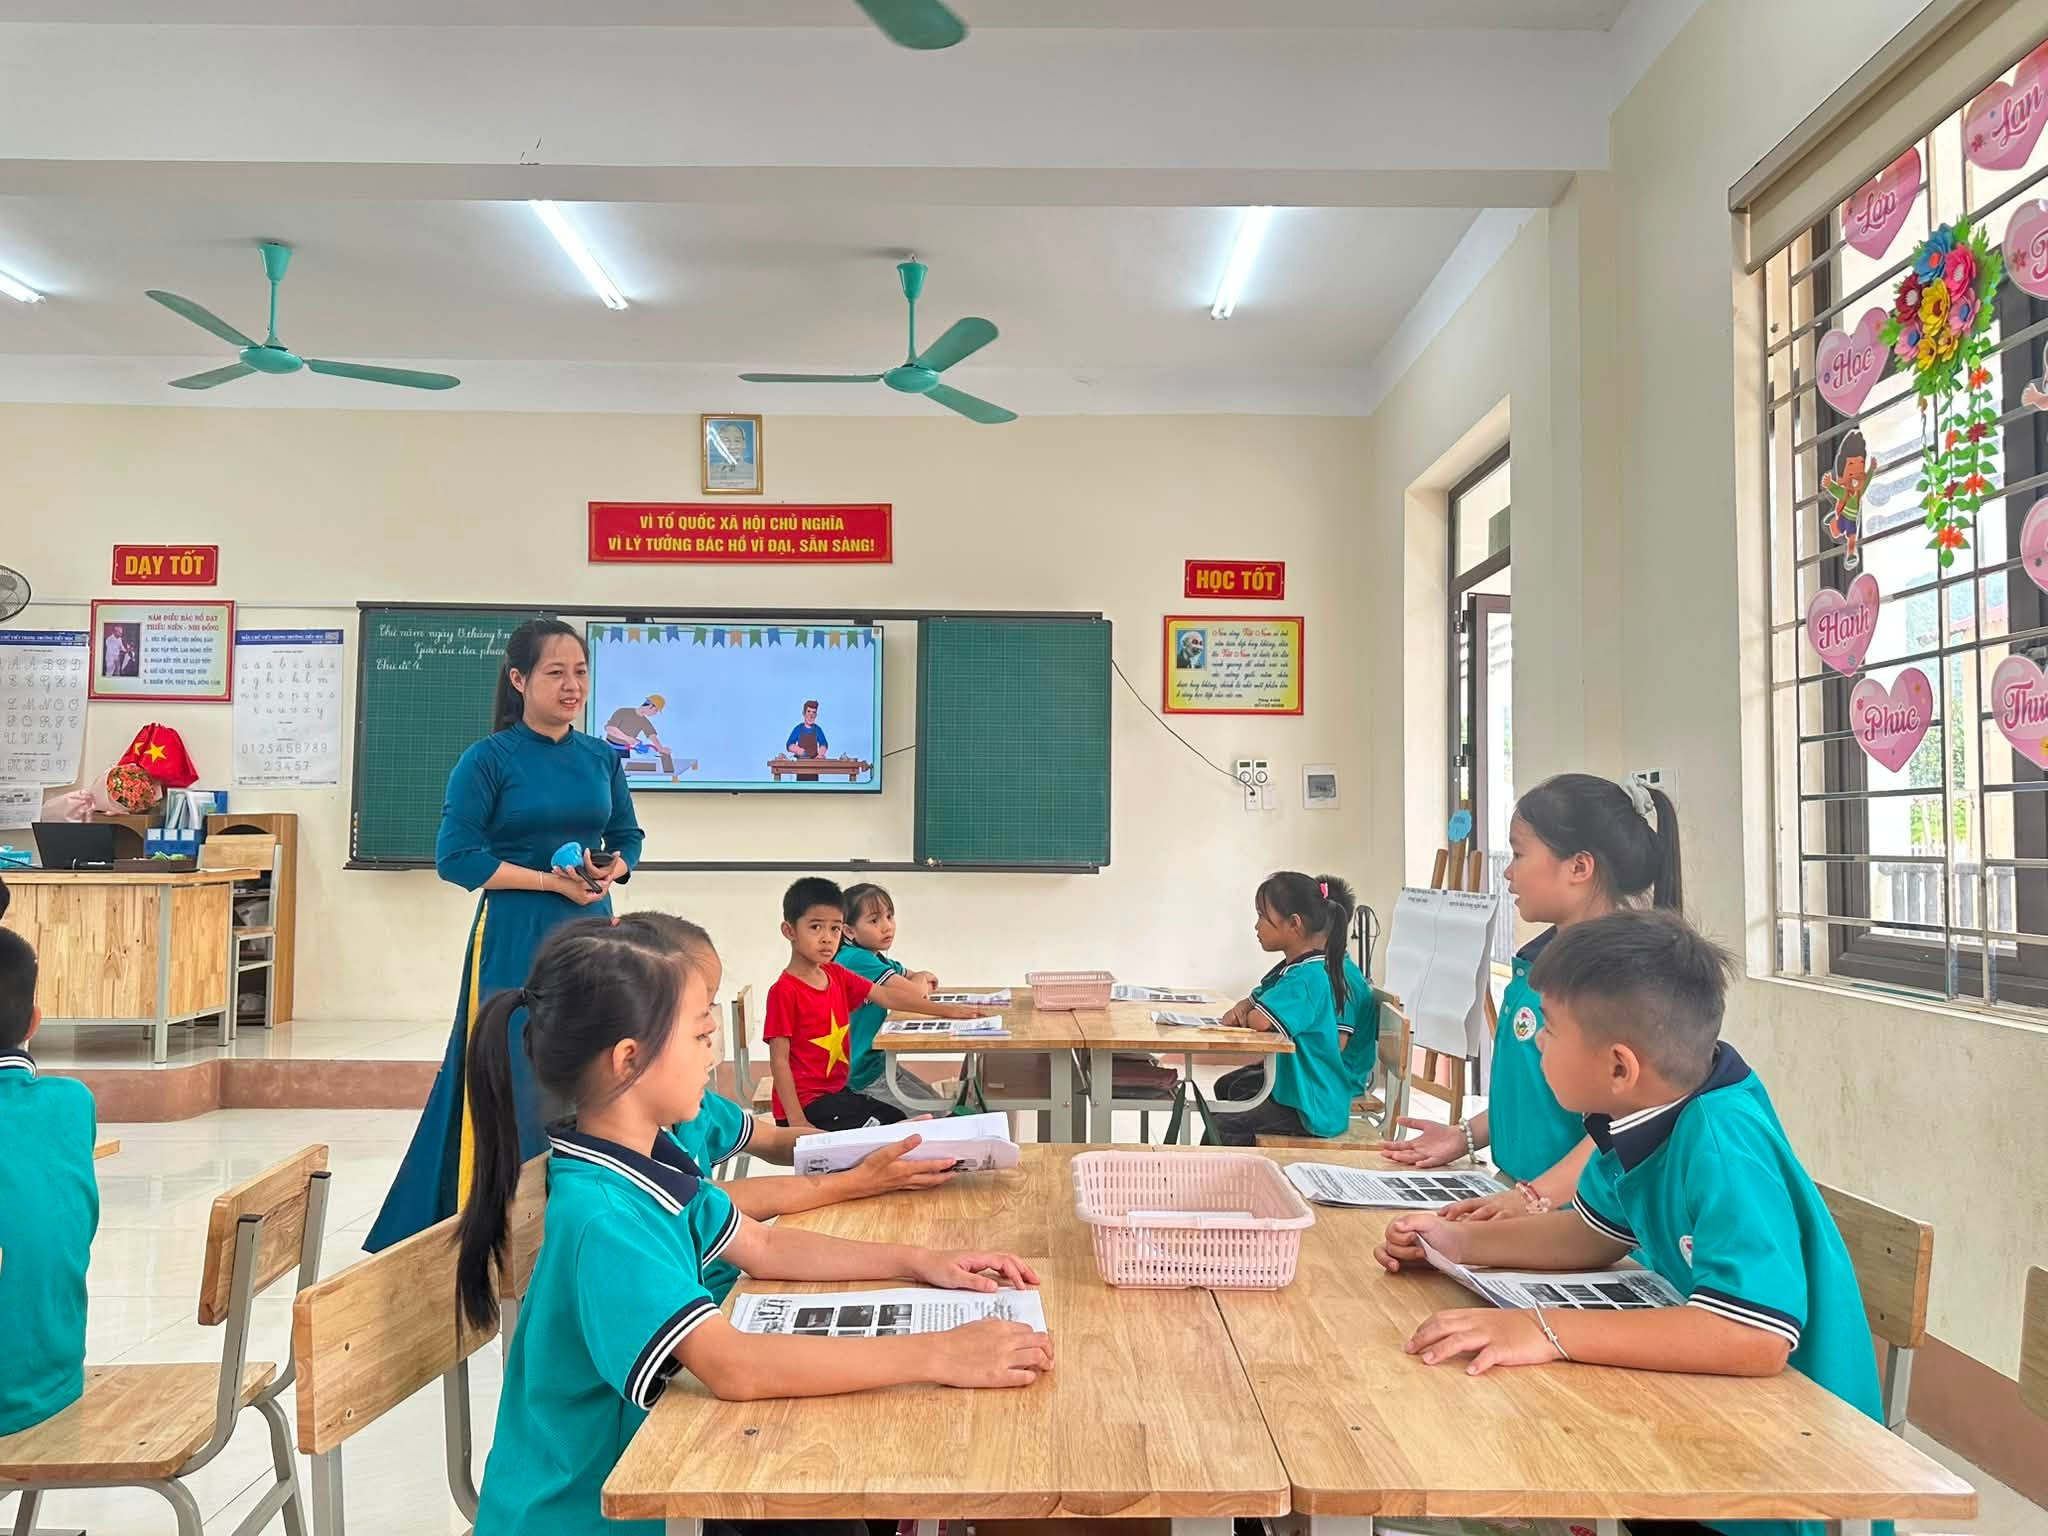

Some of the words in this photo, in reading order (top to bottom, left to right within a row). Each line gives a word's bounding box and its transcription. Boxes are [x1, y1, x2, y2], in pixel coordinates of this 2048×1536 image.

[1991, 85, 2043, 147] Lan
[1856, 190, 1897, 234] Lớp
[1832, 347, 1873, 389] Học
[640, 512, 653, 529] VÌ
[678, 511, 716, 531] QUỐC
[720, 514, 738, 530] XÃ
[742, 514, 766, 533] HỘI
[770, 512, 798, 531] CHỦ
[802, 514, 844, 531] NGHĨA
[608, 534, 622, 551] VÌ
[625, 534, 641, 551] LÝ
[645, 533, 692, 552] TƯỞNG
[696, 535, 724, 552] BÁC
[125, 555, 164, 579] DẠY
[169, 549, 205, 576] TỐT
[1195, 569, 1235, 593] HỌC
[1241, 566, 1276, 592] TỐT
[1818, 604, 1870, 650] Hạnh
[1864, 704, 1920, 742] Phúc
